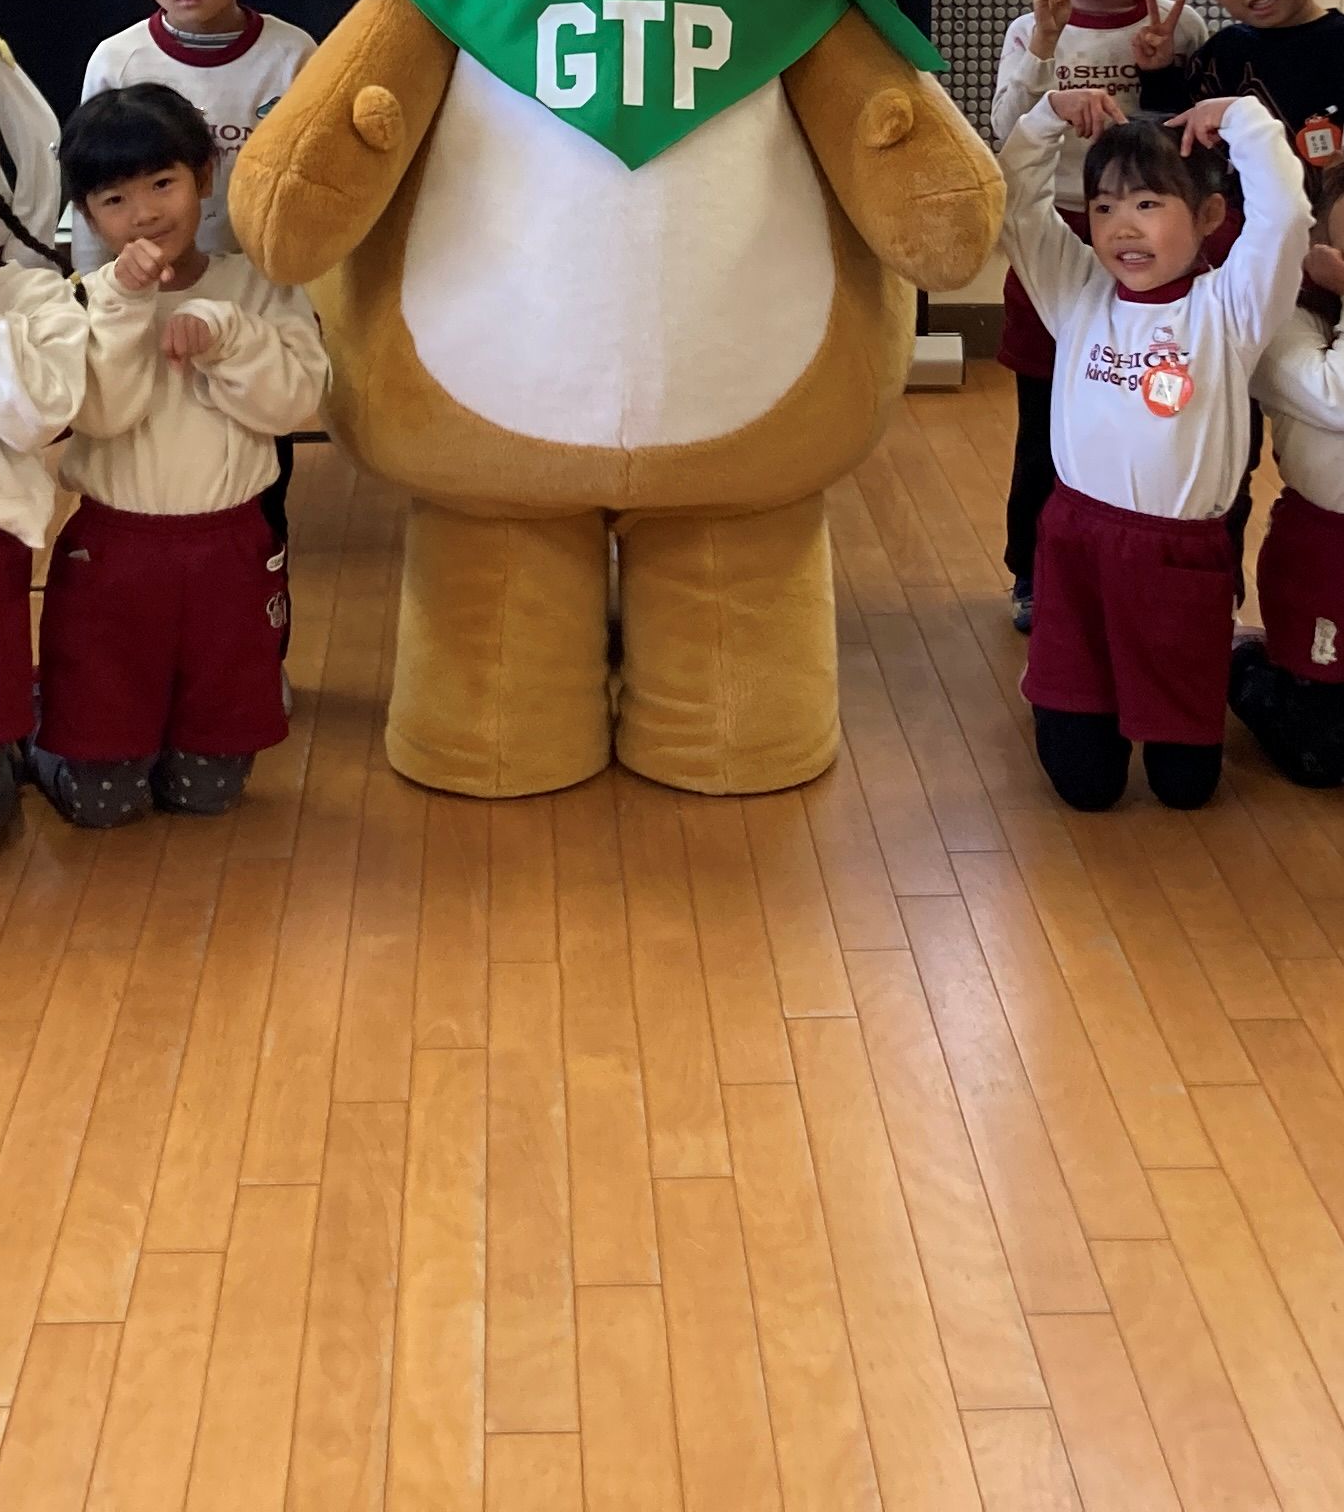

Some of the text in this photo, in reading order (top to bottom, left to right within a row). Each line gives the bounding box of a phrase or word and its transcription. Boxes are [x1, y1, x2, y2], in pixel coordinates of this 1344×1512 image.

[536, 0, 733, 110] GTP
[1074, 64, 1140, 79] SHIO
[1101, 346, 1189, 369] SHIO
